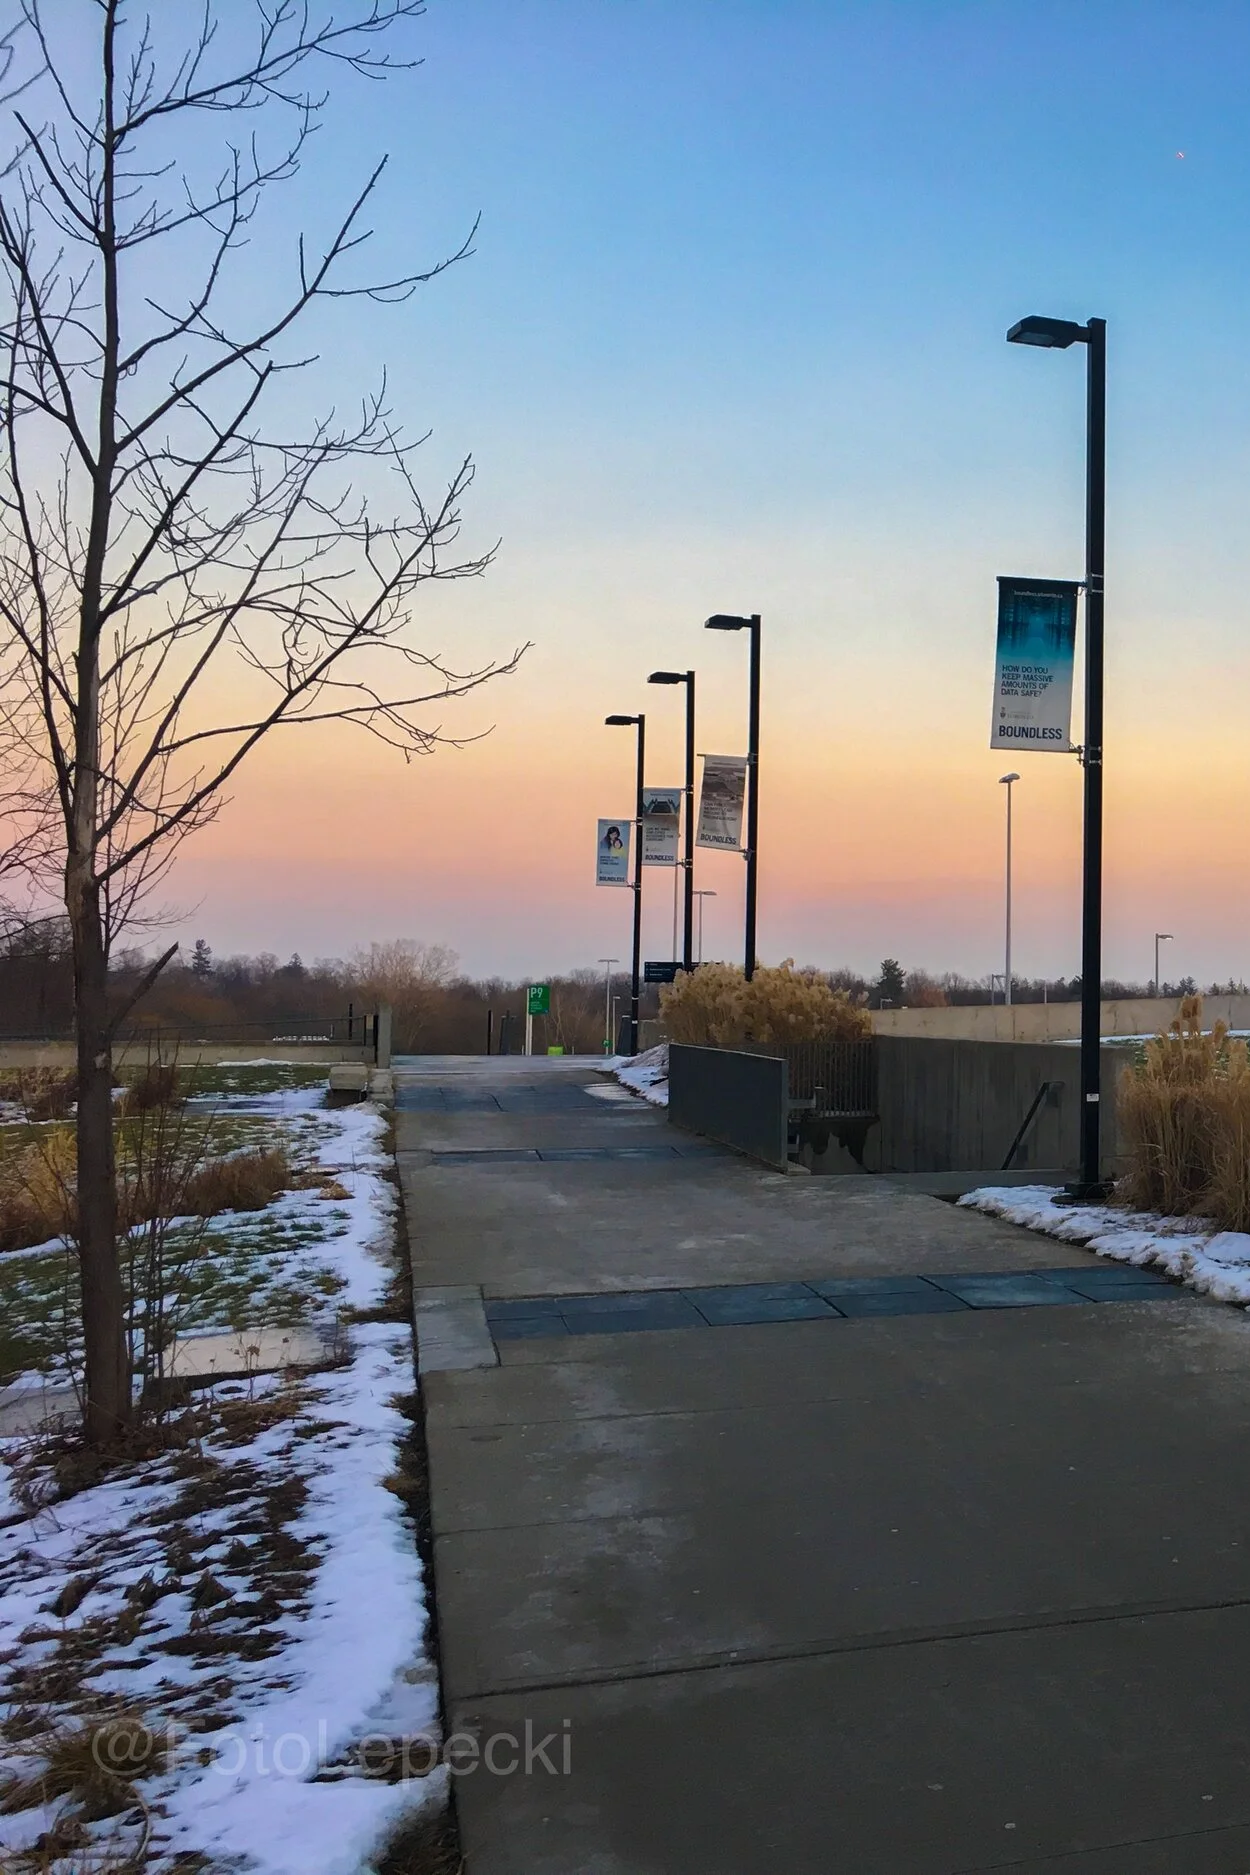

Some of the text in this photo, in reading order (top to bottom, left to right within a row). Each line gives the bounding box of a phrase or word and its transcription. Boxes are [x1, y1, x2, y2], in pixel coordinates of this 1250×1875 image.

[1002, 664, 1049, 675] HOW DO YOU
[1001, 672, 1054, 683] KEEP MASSIVE
[1000, 681, 1049, 690] AMOUNTS OF
[1000, 688, 1042, 698] DATA SAFE?
[998, 725, 1063, 740] BOUNDLESS
[700, 833, 737, 845] BOUNDLESS
[530, 987, 543, 999] P9
